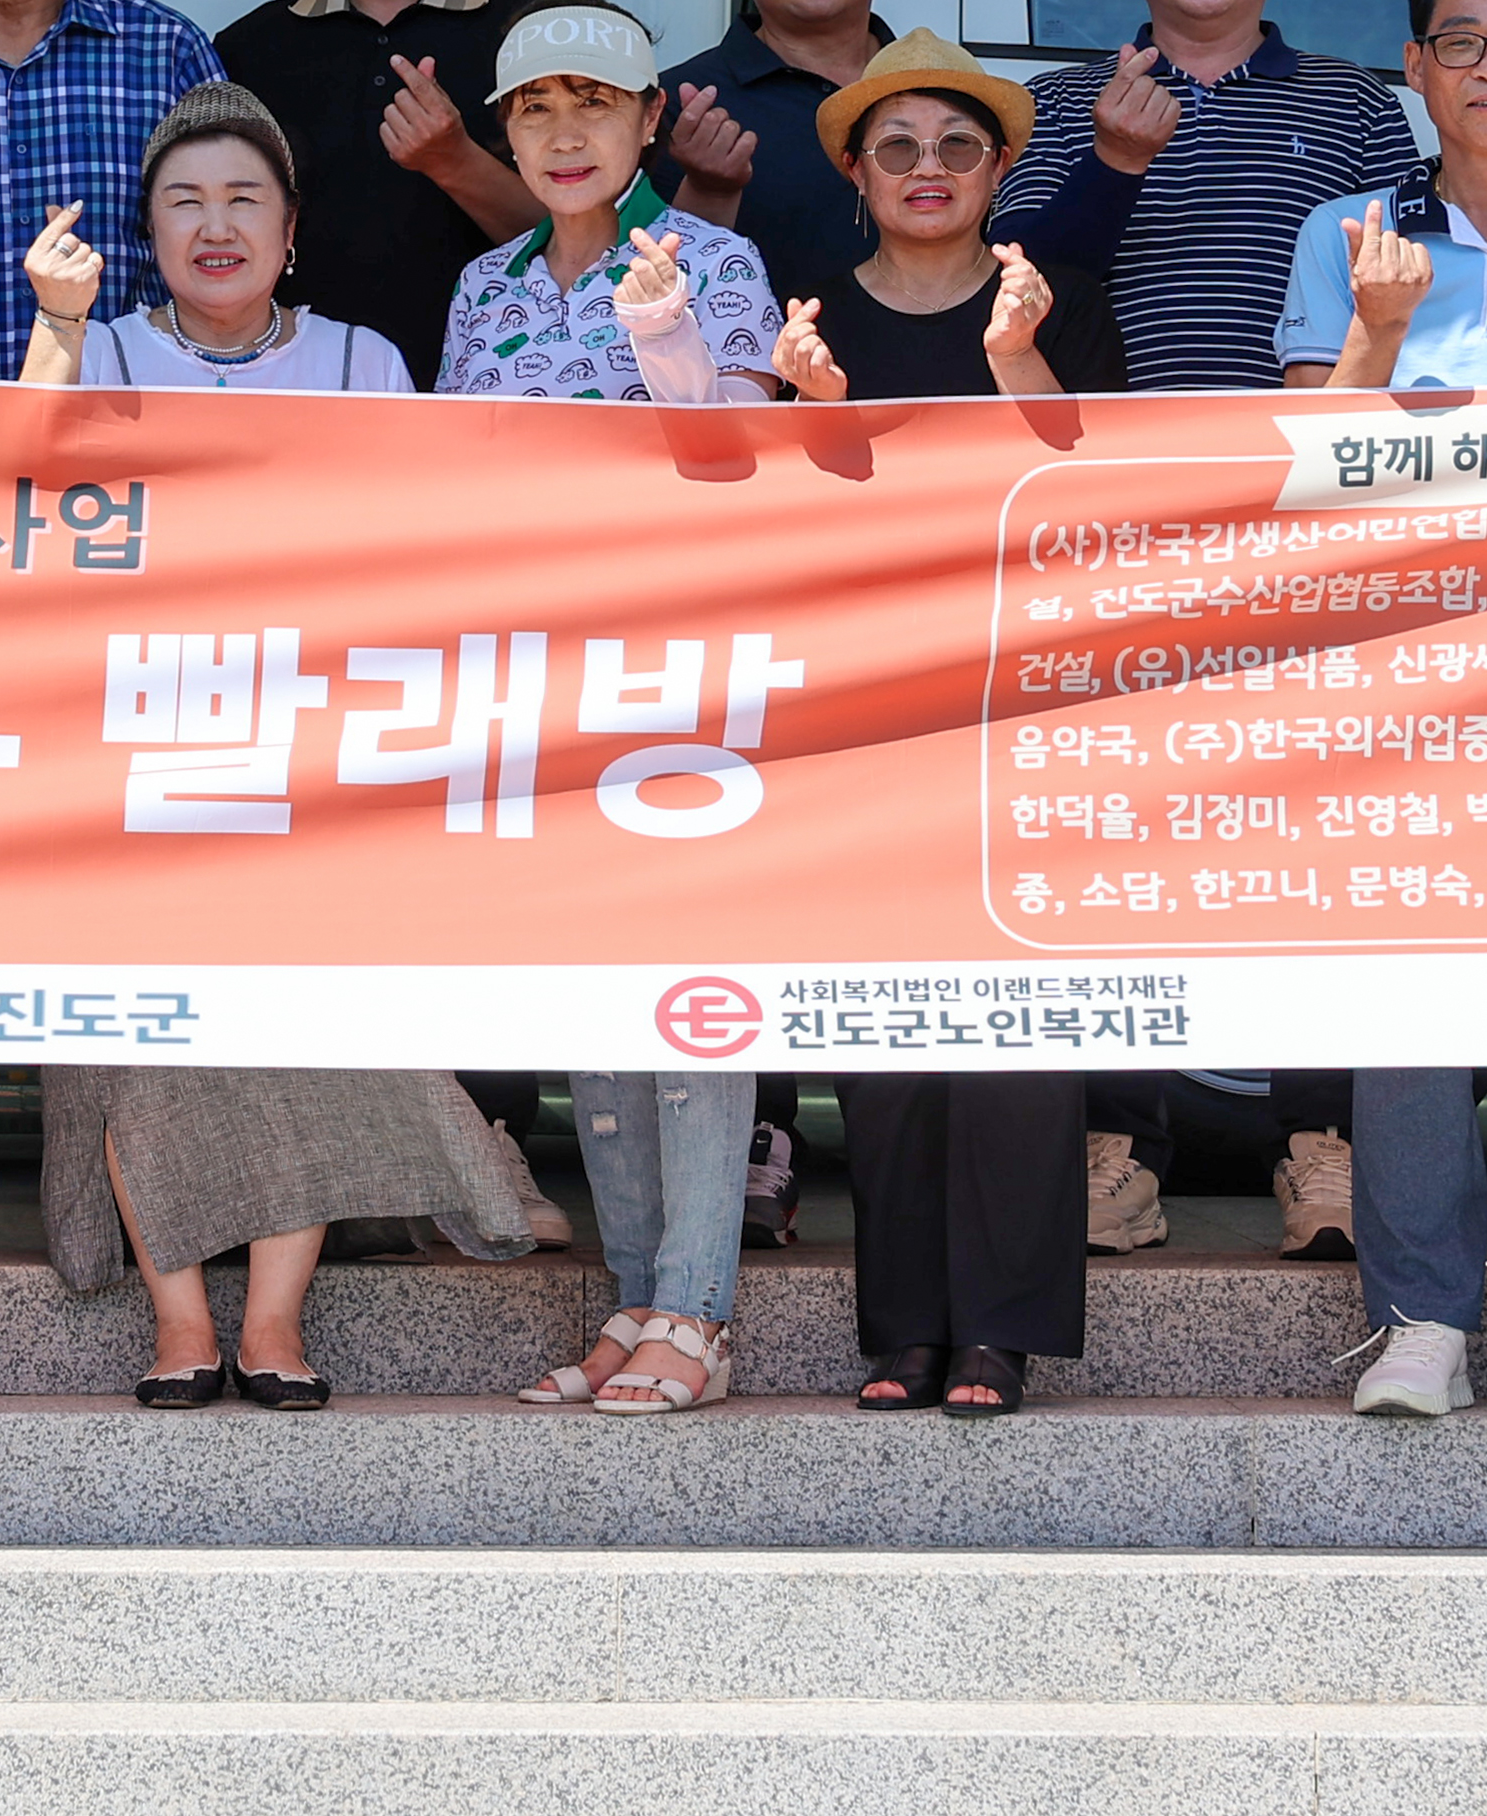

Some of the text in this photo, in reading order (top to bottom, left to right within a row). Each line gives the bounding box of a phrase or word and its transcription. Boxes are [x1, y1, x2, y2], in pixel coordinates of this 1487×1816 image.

[500, 17, 640, 74] SPORT
[716, 300, 741, 310] YEAH!
[1330, 433, 1434, 489] 함께
[1089, 565, 1487, 620] 진도군수산업협동조합,
[1016, 650, 1103, 695] 건설,
[1113, 643, 1373, 694] (유)선일식품,
[100, 625, 808, 840] 빨래방
[1009, 724, 1150, 770] 음약국,
[1009, 792, 1150, 842] 한덕율,
[1164, 792, 1302, 842] 김정미,
[1315, 791, 1454, 839] 진영철,
[1011, 871, 1066, 916] 종,
[1079, 871, 1179, 915] 소담,
[1190, 866, 1332, 912] 한끄니,
[1345, 864, 1486, 910] 문병숙,
[779, 974, 1188, 1005] 사회복지법인 이랜드복지재단
[780, 1004, 1190, 1050] 진도군노인복지관
